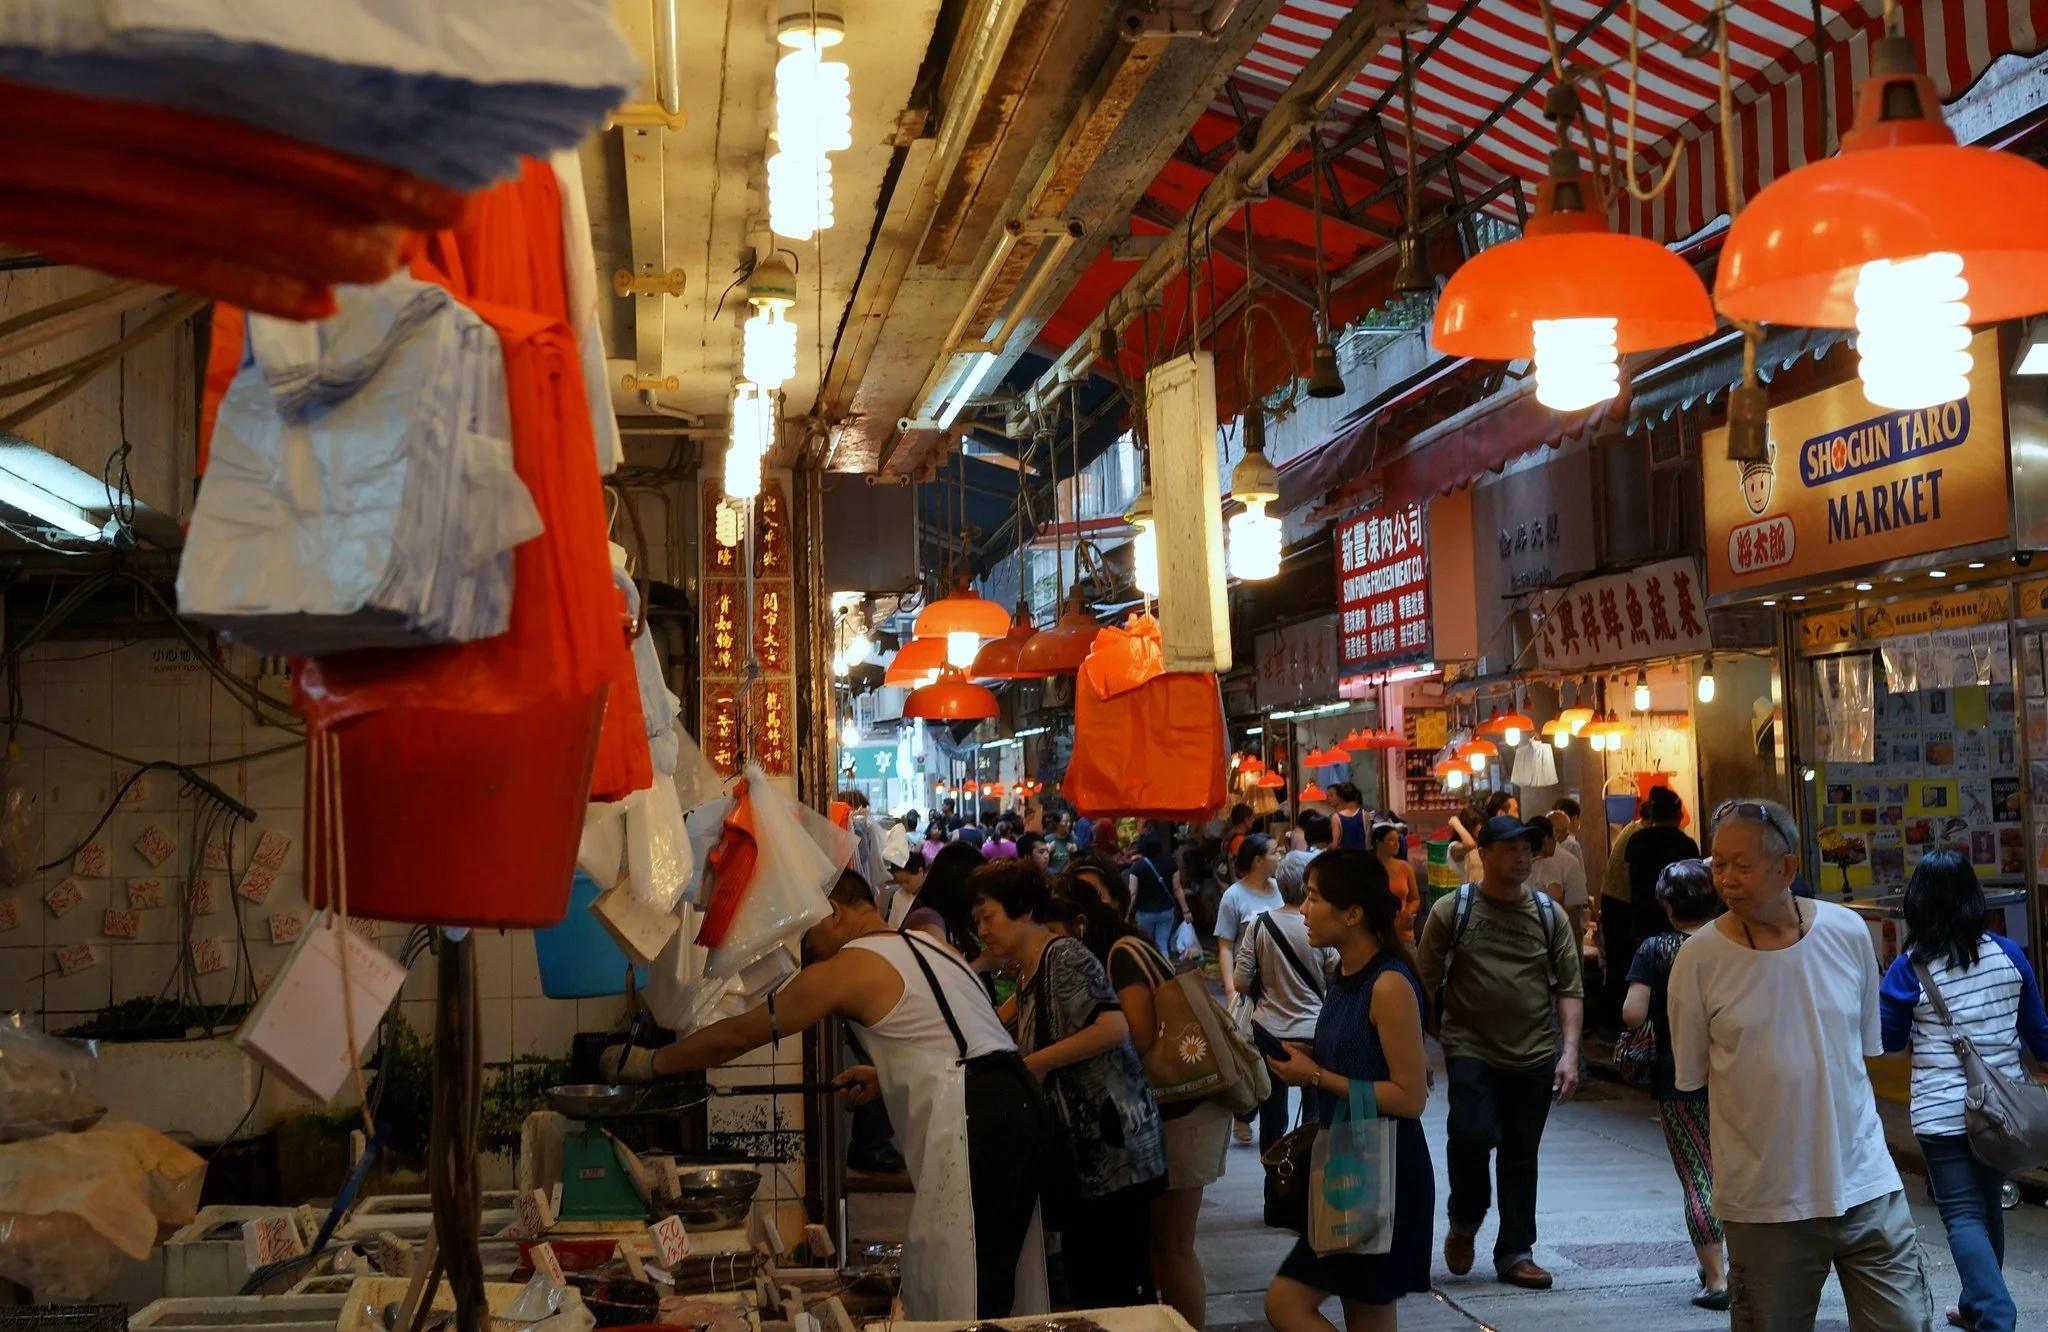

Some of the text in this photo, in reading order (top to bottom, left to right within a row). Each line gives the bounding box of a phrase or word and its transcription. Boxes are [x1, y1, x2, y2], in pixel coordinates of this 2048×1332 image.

[1807, 399, 1962, 481] SHOGUN TARO
[1341, 503, 1422, 573] 新豐凍肉公司
[1828, 469, 1943, 544] MARKET
[1370, 564, 1395, 595] FROZEN
[1394, 558, 1412, 588] MEAT
[1411, 554, 1424, 582] CO.
[1399, 590, 1425, 620] 零售批發
